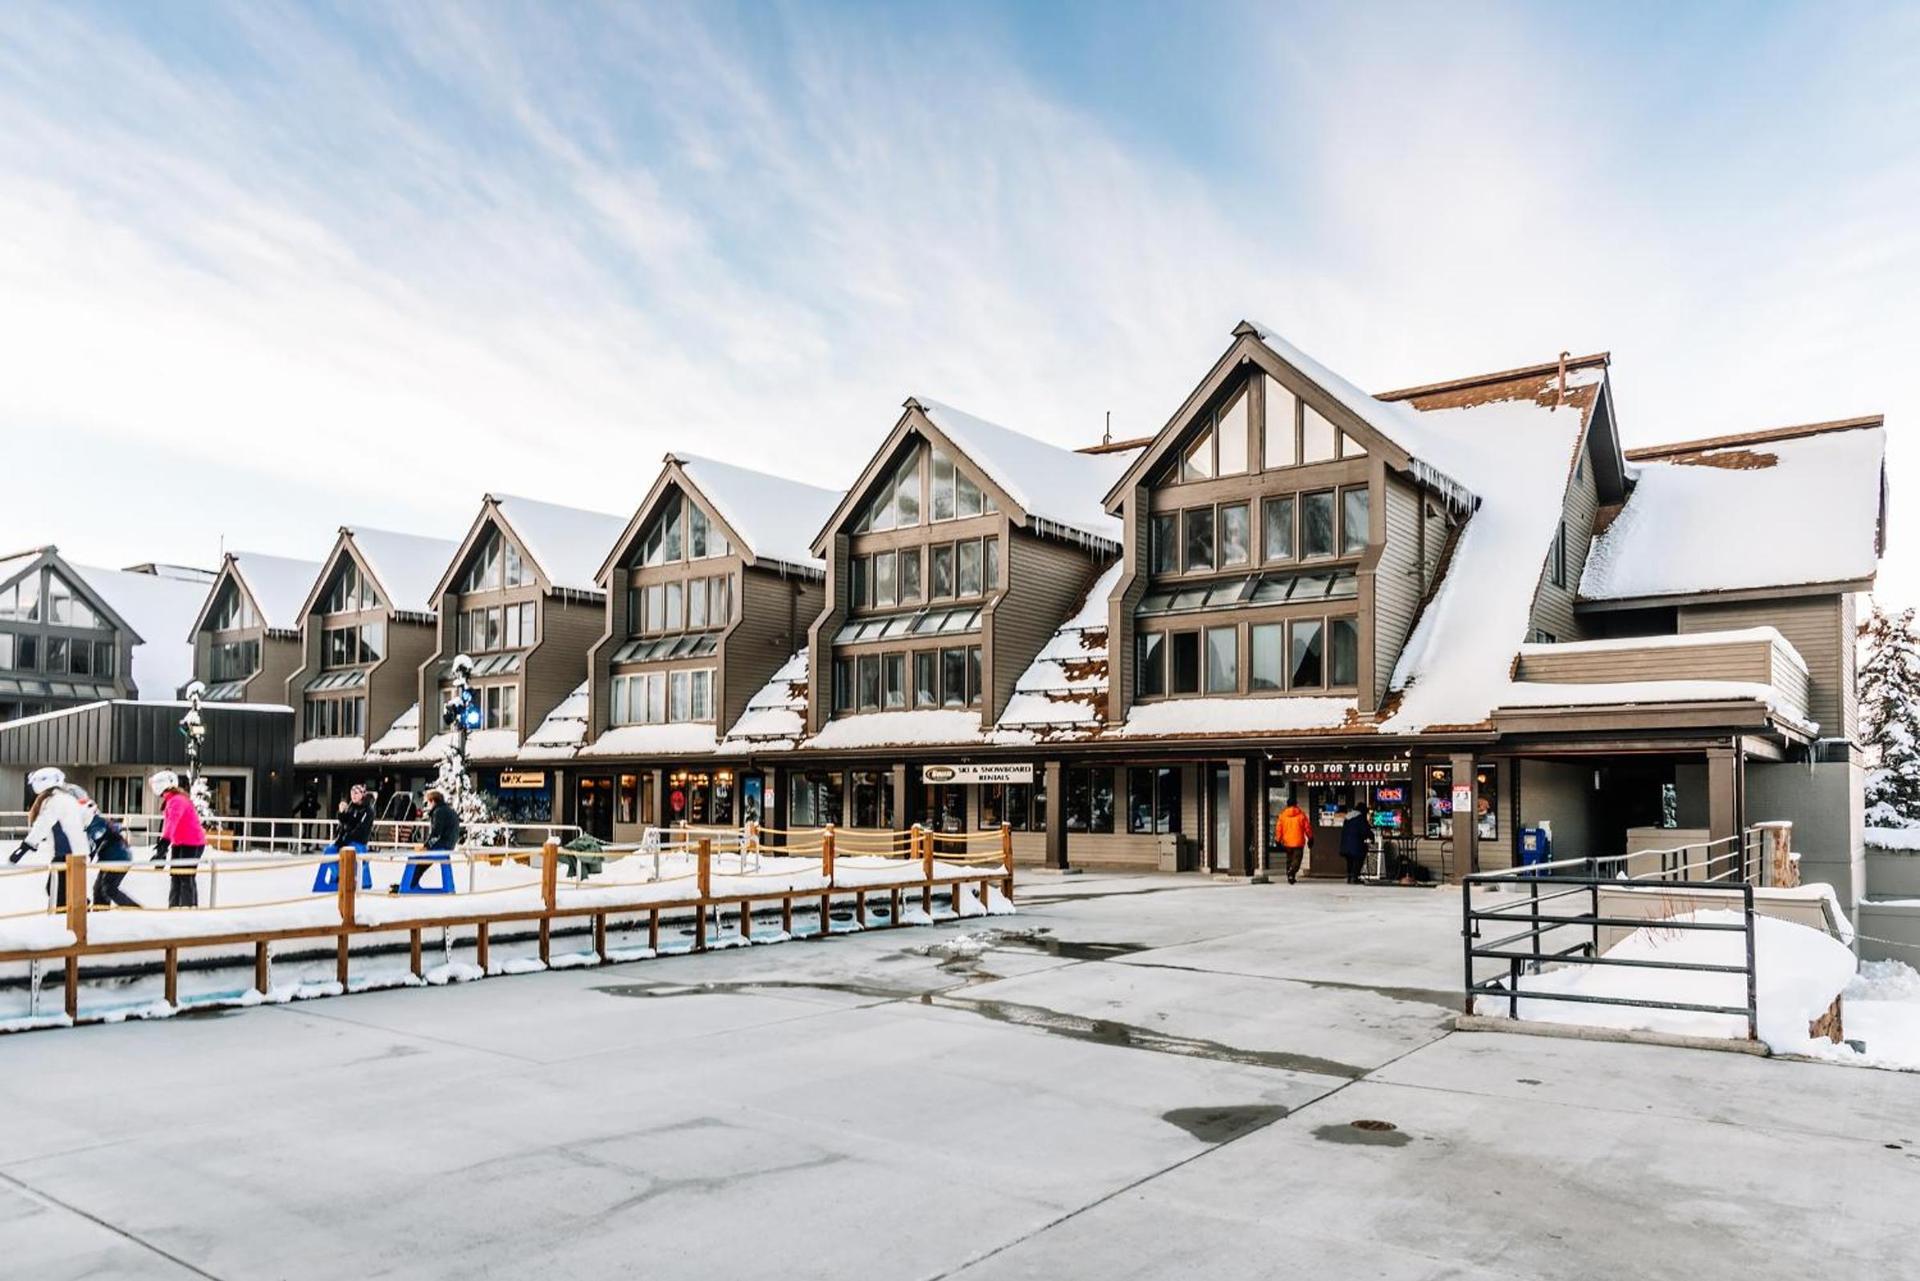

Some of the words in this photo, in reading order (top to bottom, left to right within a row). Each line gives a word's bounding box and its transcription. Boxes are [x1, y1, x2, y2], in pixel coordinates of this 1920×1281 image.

[1285, 764, 1316, 773] FOOD
[1323, 764, 1343, 773] FOR
[1349, 763, 1409, 772] THOUGHT
[1379, 788, 1402, 799] OPEN
